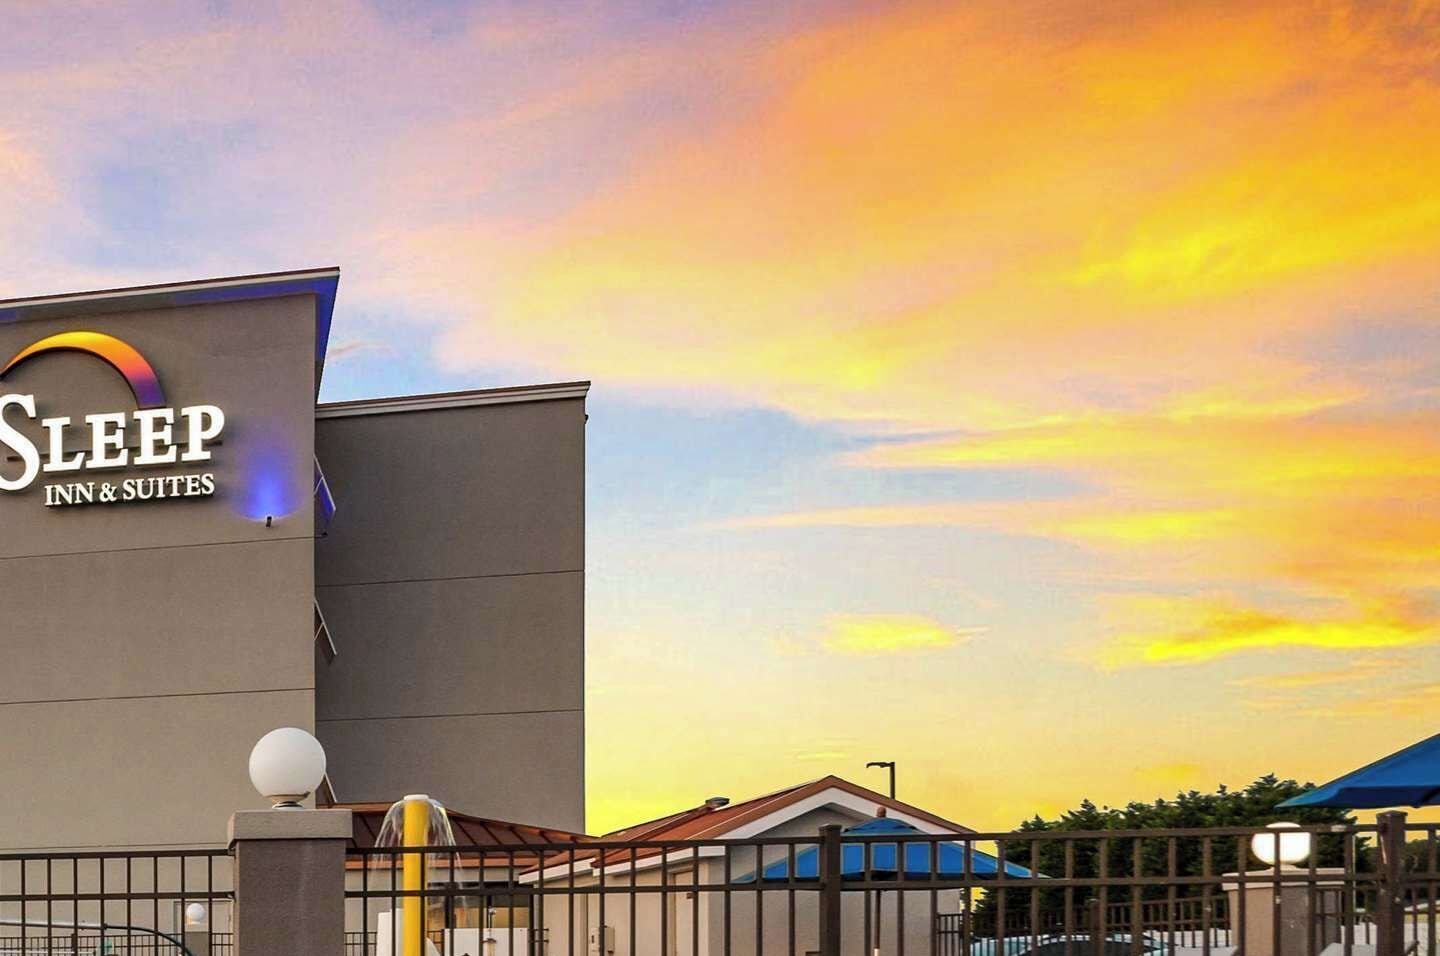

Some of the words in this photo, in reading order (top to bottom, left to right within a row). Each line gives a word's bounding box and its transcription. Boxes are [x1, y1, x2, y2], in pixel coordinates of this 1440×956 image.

[44, 482, 95, 506] INN
[98, 483, 117, 503] &
[122, 473, 215, 500] SUITES
